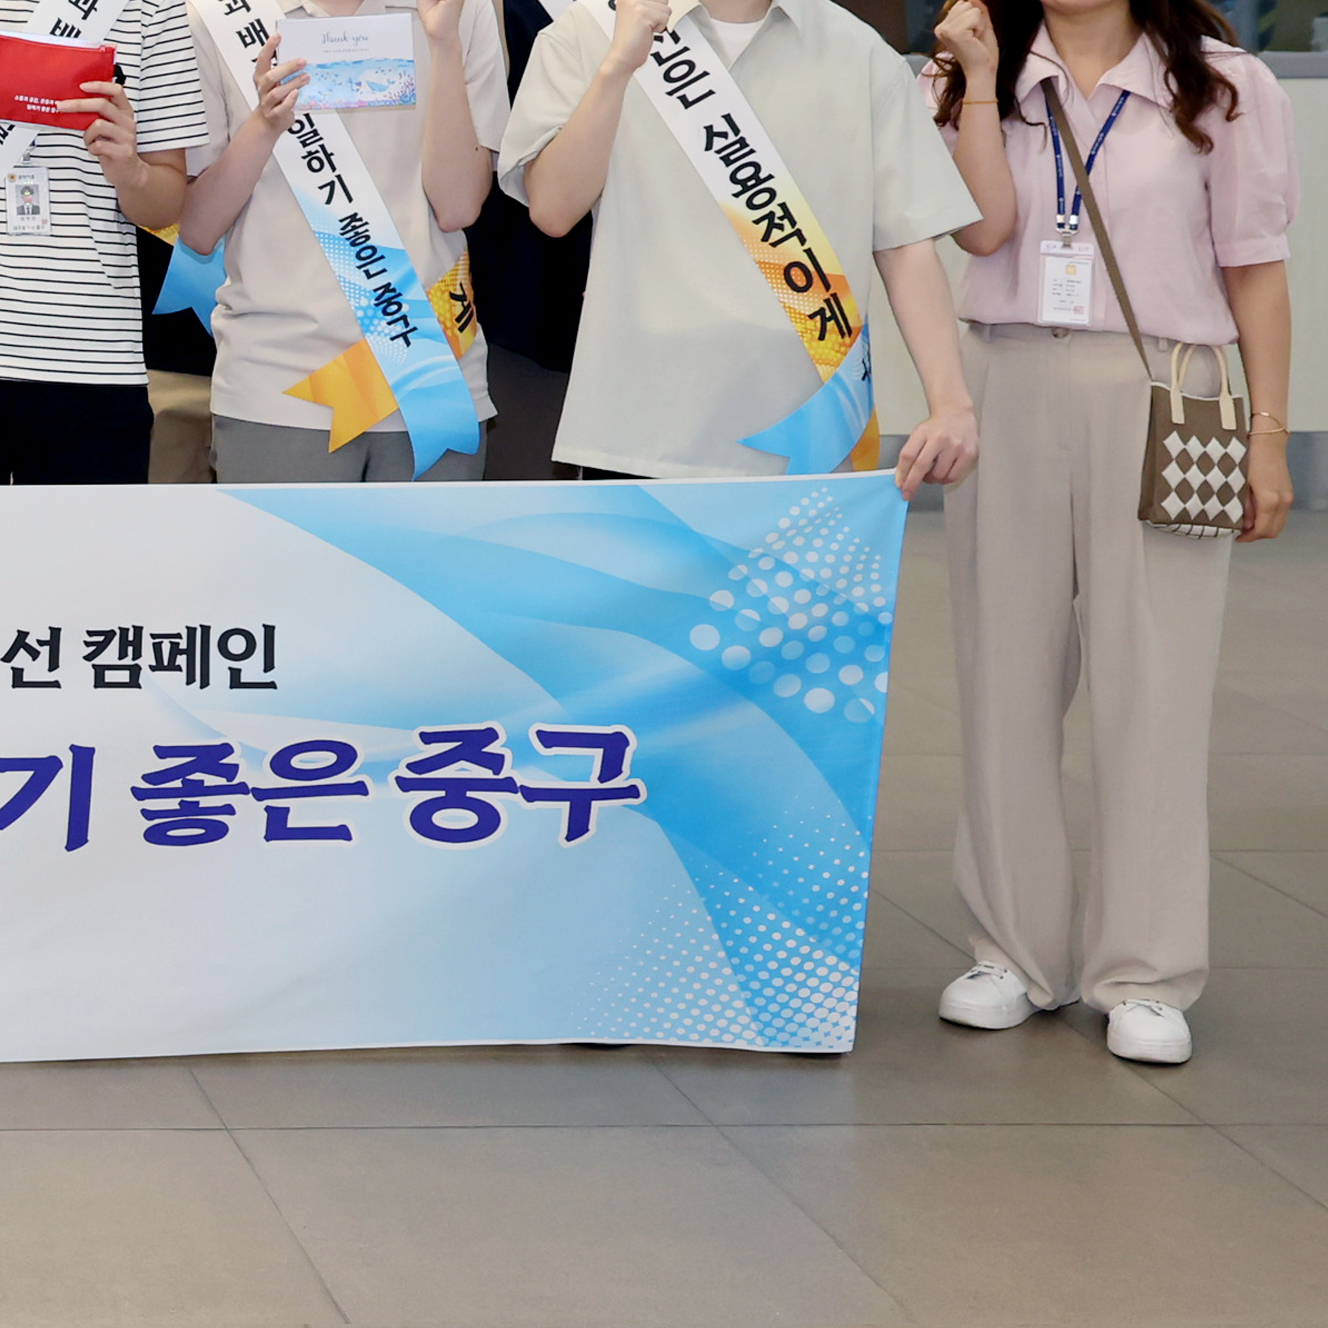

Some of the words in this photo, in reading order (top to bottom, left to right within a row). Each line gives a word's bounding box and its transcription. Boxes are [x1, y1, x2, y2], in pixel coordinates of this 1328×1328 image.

[321, 31, 349, 44] Thank
[352, 34, 369, 46] you
[287, 113, 354, 205] 일하기
[338, 212, 388, 280] 좋은
[372, 281, 419, 338] 중구
[704, 112, 852, 342] 실용적이게
[82, 623, 278, 690] 캠페인
[130, 736, 368, 846] 좋은
[394, 724, 648, 846] 중구
